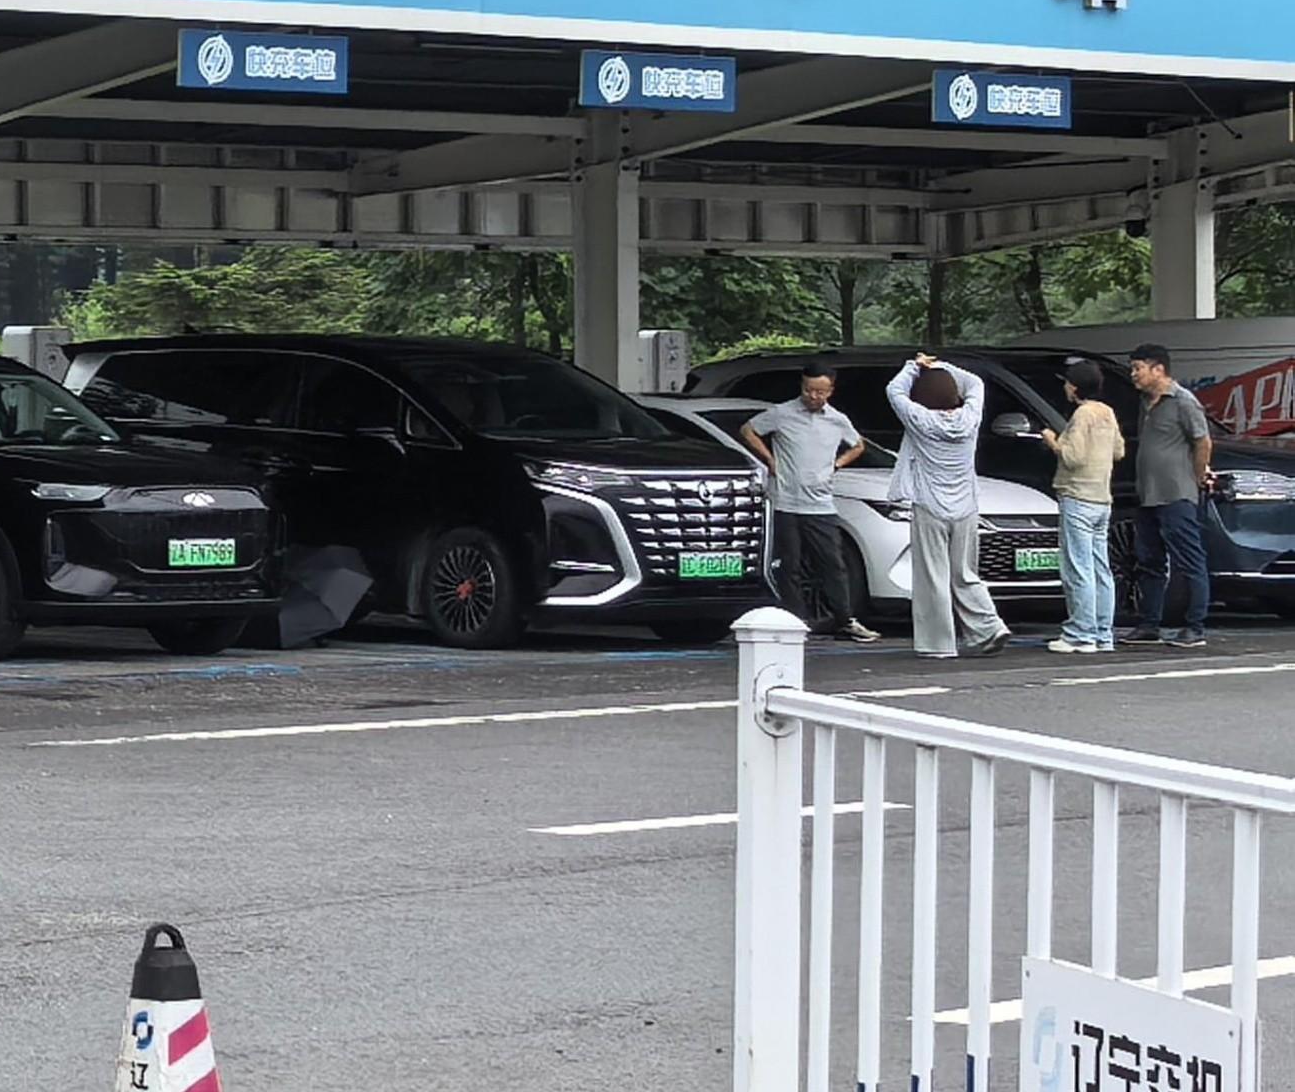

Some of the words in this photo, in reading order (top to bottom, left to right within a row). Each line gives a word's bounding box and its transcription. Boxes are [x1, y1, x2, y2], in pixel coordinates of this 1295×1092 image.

[245, 45, 336, 82] 快充车位
[642, 67, 725, 102] 快充车位
[987, 84, 1062, 118] 快充车位
